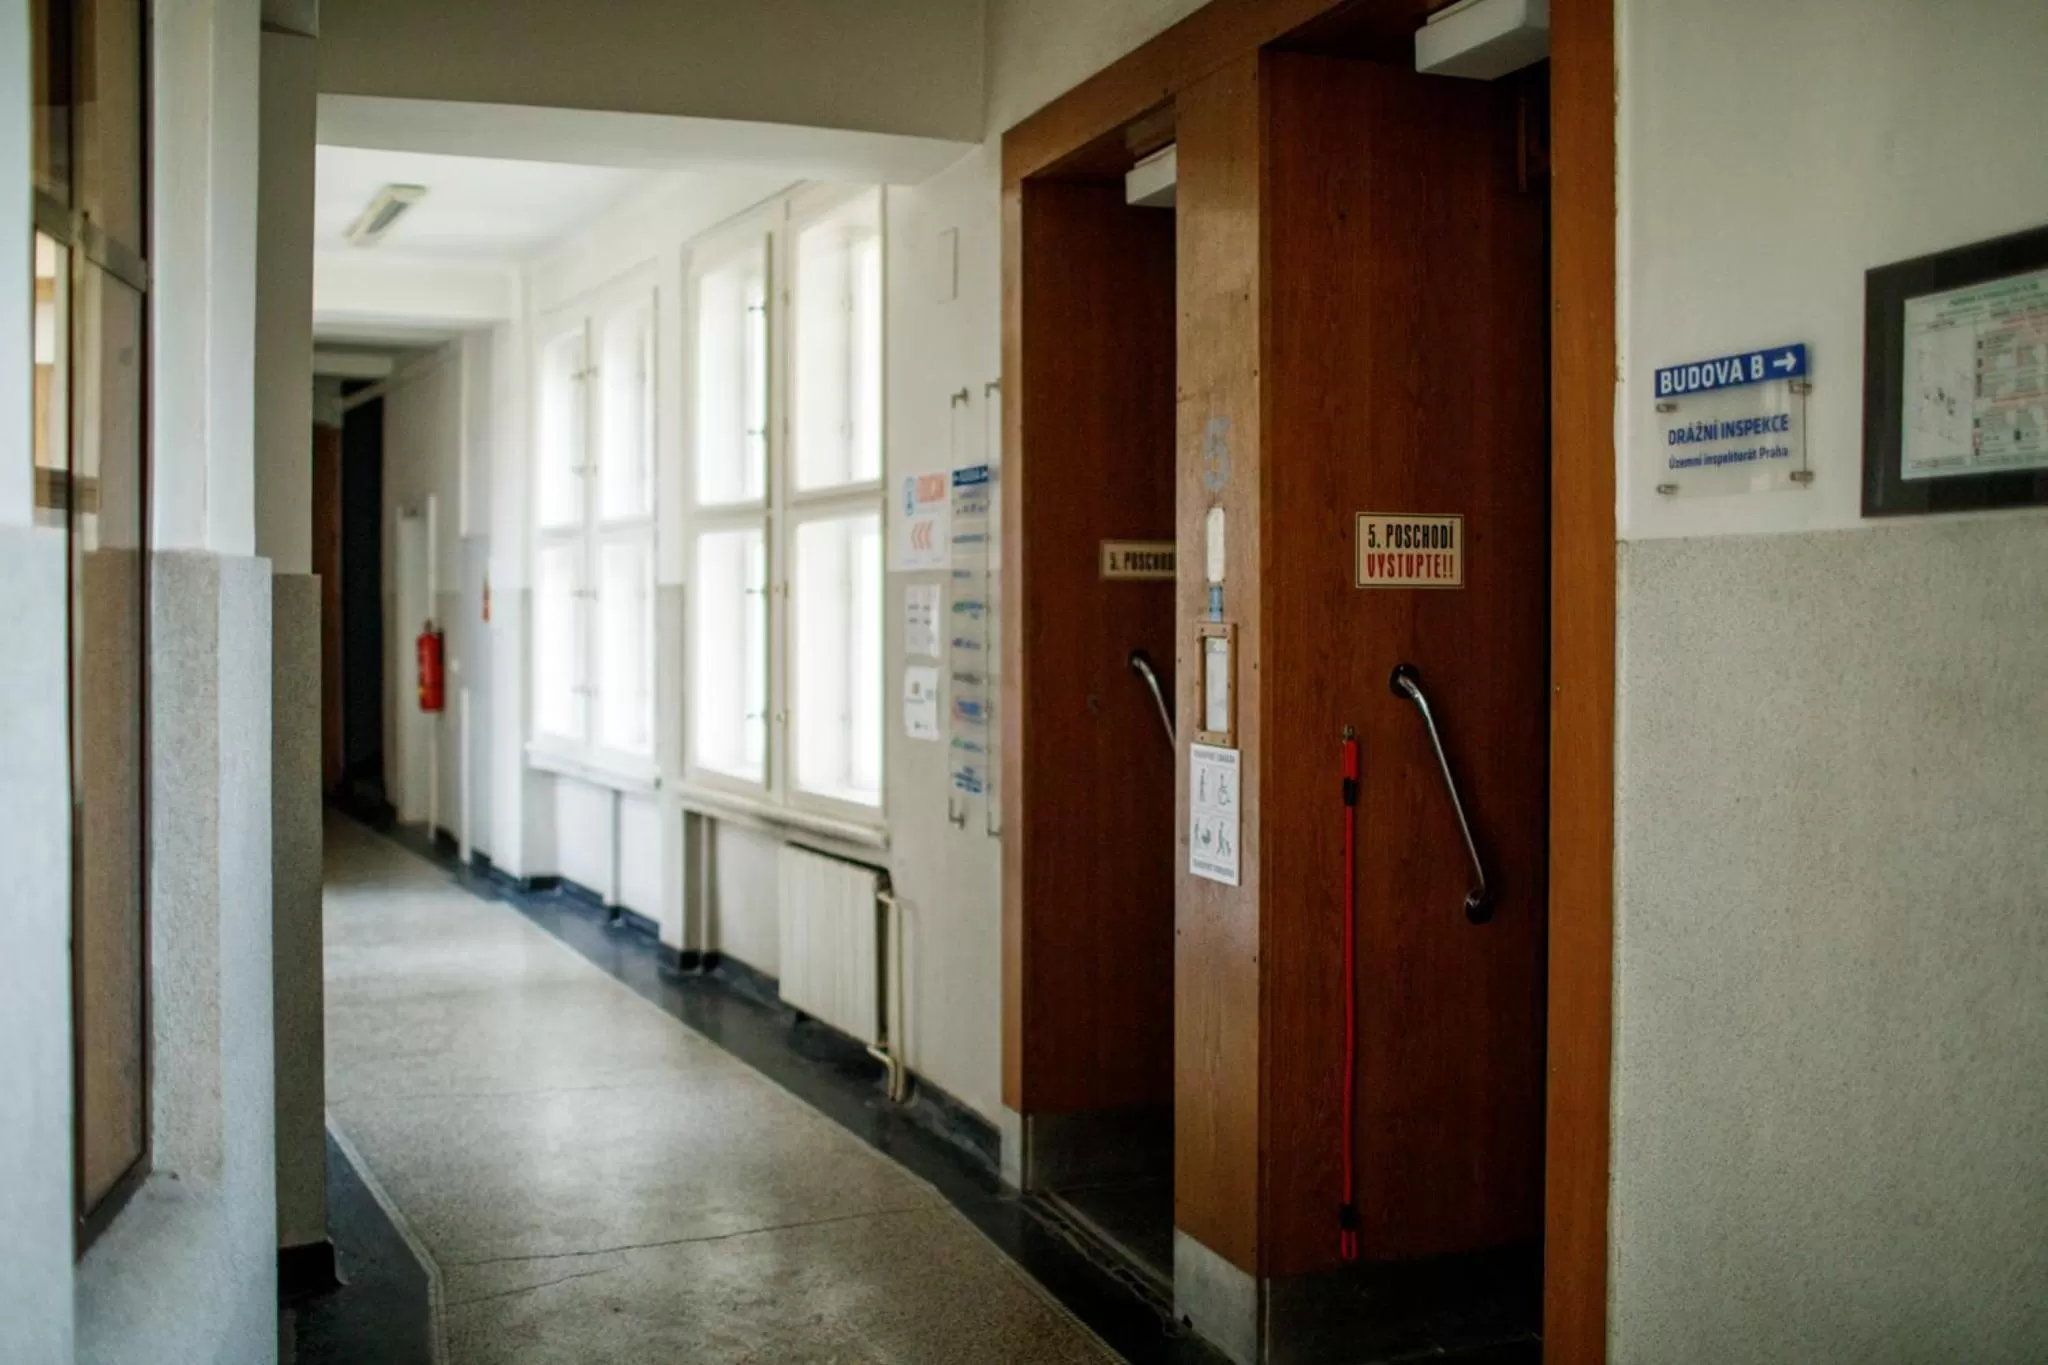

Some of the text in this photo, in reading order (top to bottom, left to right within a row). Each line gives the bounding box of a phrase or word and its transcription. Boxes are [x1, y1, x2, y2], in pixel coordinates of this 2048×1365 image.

[1660, 354, 1765, 395] BUDOVA B
[1668, 413, 1790, 446] DRÁŽNÍ INSPEKCE
[1759, 443, 1789, 460] Praha
[1367, 520, 1454, 549] 5. POSCHODÍ
[1367, 552, 1454, 580] VYSTUPTE!!
